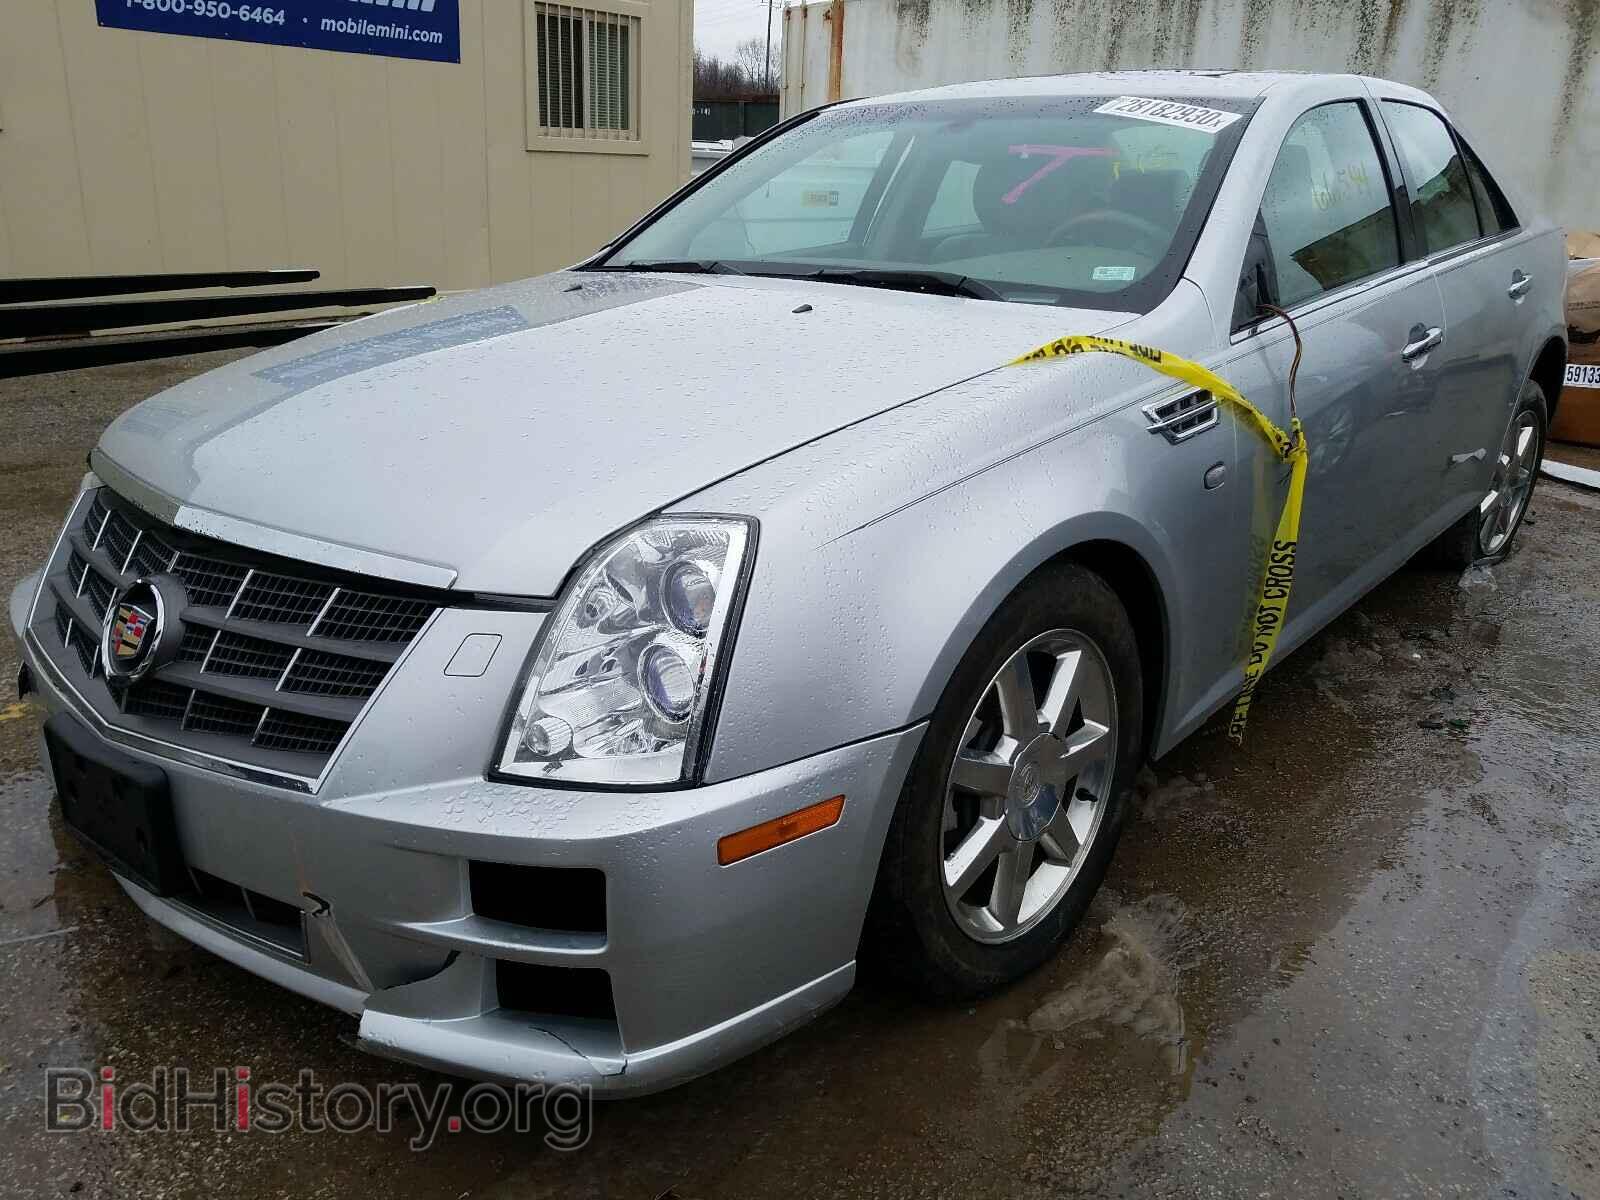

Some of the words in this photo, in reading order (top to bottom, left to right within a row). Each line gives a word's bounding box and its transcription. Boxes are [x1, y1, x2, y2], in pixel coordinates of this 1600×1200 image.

[320, 18, 443, 44] mobilemini.com
[1263, 540, 1297, 601] CROSS
[1255, 604, 1282, 638] NOT
